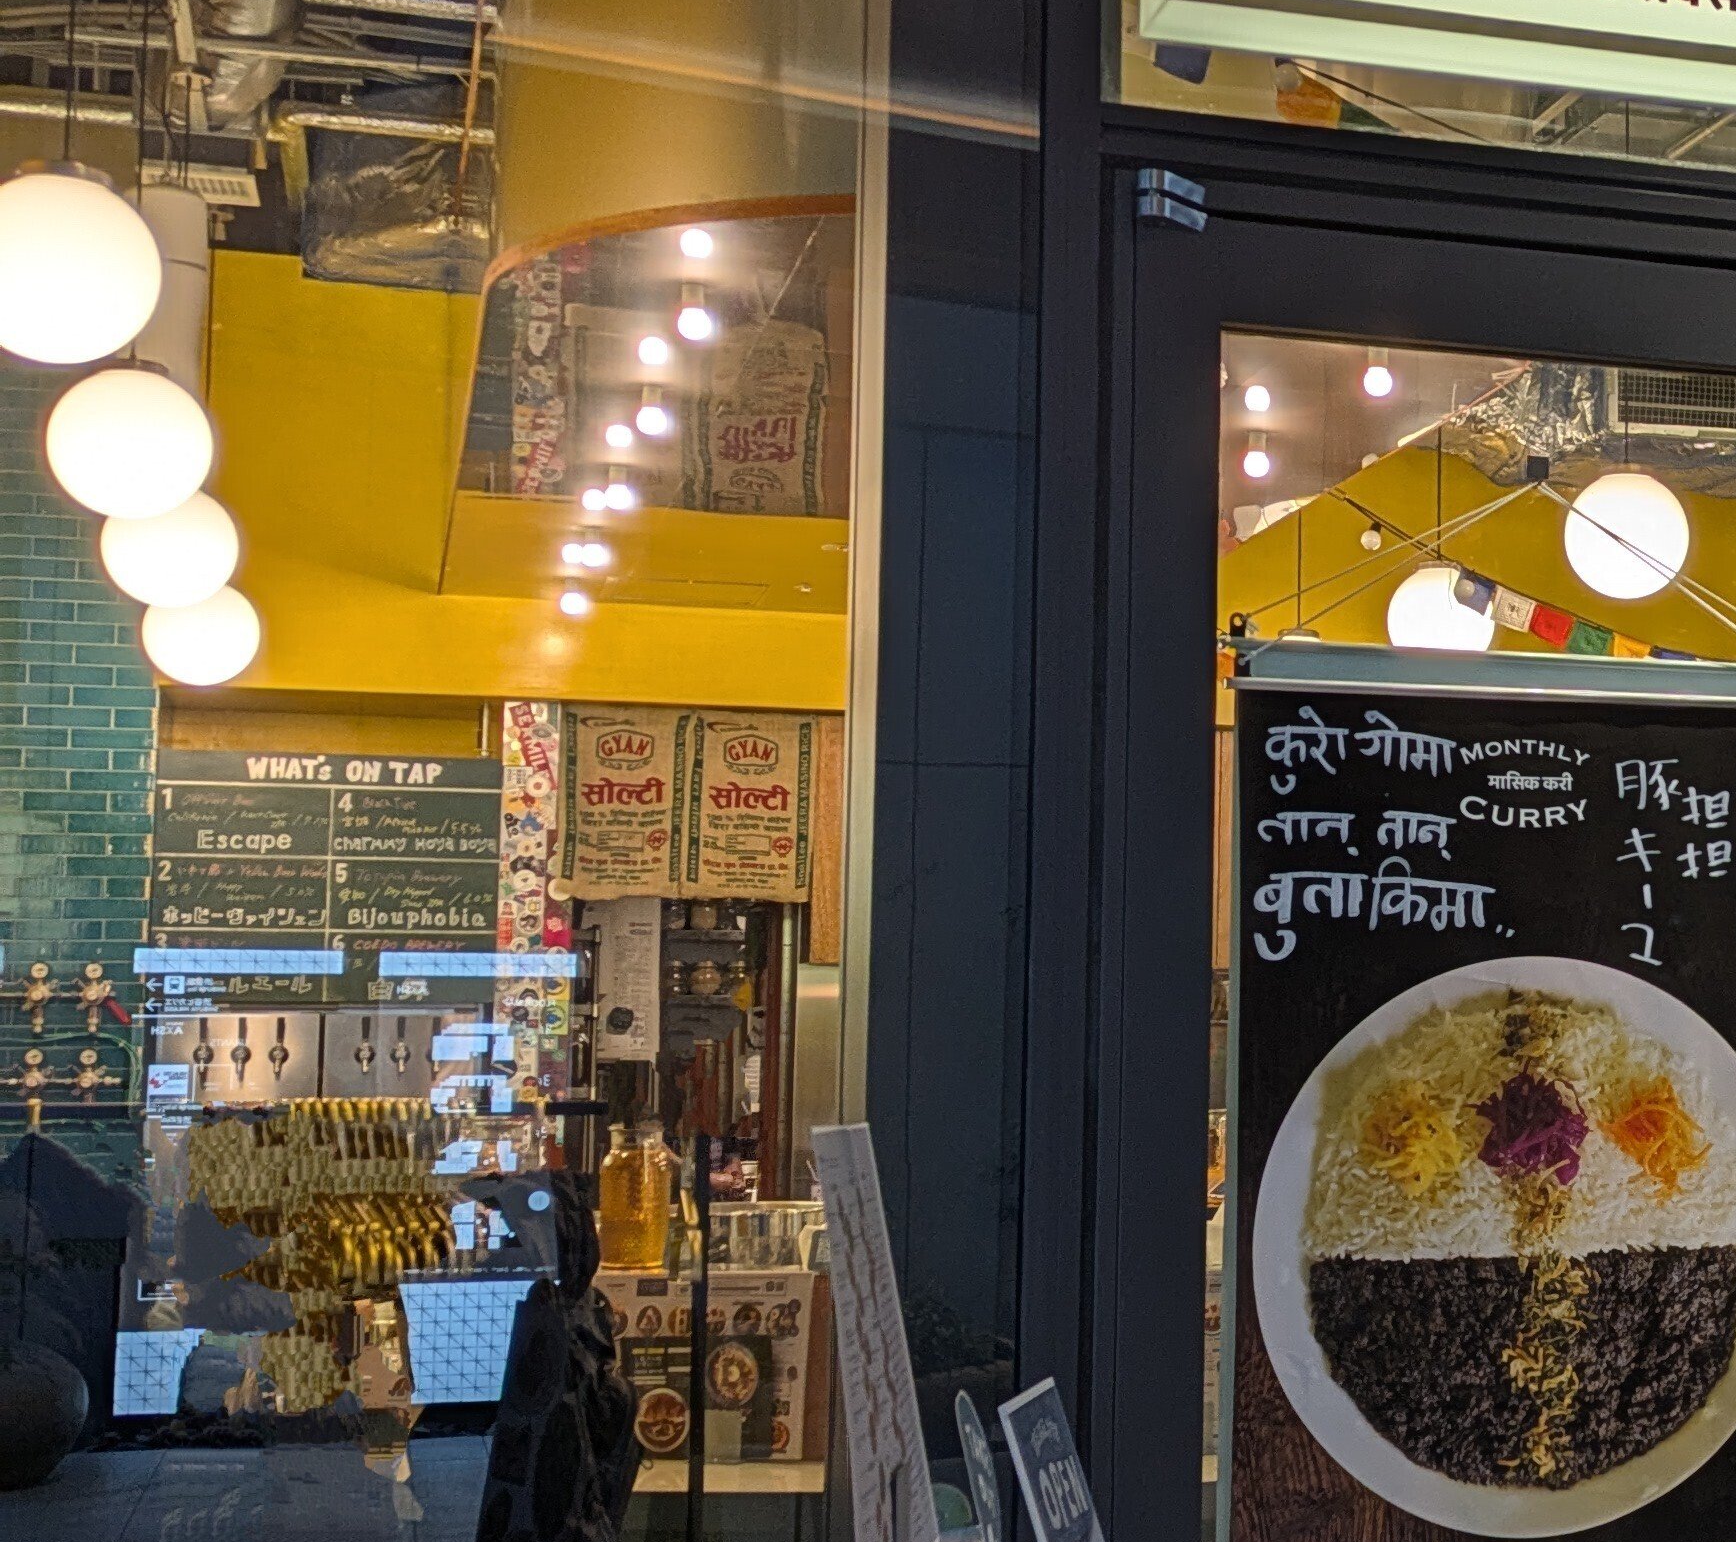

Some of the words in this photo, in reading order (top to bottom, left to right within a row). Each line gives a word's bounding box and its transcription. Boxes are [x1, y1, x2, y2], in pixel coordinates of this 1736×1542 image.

[600, 733, 650, 758] GYAN
[727, 739, 775, 763] GYAN
[1459, 738, 1590, 767] MONTHLY
[346, 762, 381, 783] ON
[389, 762, 443, 784] TAP
[1543, 771, 1573, 793] करी
[162, 789, 173, 809] 1
[338, 793, 353, 812] 4
[1458, 795, 1589, 829] CURRY
[197, 828, 293, 855] Escape
[157, 860, 172, 881] 2
[335, 862, 348, 884] 5
[1039, 1455, 1089, 1531] OPEN
